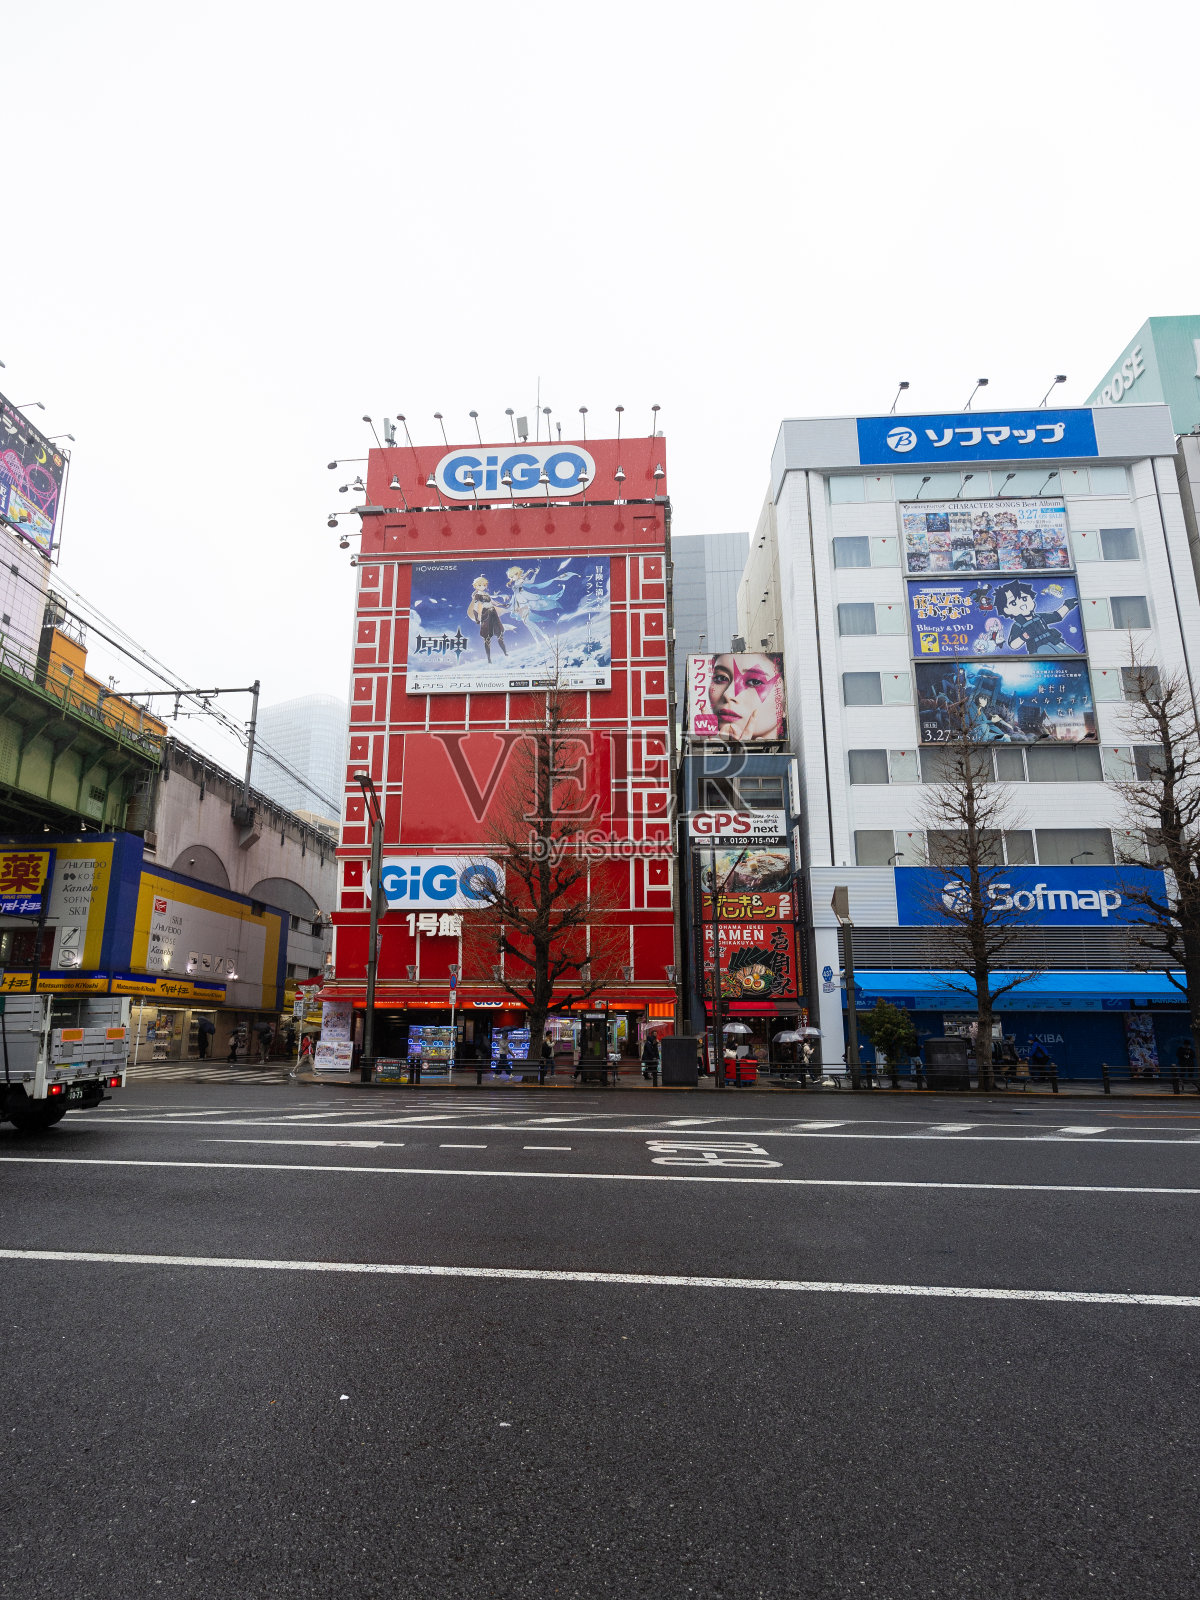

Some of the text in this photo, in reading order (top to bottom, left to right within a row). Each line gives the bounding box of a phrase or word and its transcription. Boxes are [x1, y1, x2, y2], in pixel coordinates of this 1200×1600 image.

[925, 422, 1066, 447] ソフマップ
[443, 451, 587, 493] GiGO
[949, 502, 994, 510] CHARACTER
[995, 501, 1020, 509] SONGS
[1018, 509, 1038, 520] 3.27
[916, 624, 944, 632] Blu-ray
[953, 623, 974, 632] DVD
[941, 633, 968, 645] 3.20
[694, 658, 707, 710] ワクワク
[924, 729, 951, 741] 3.27
[692, 813, 751, 834] GPS
[753, 825, 779, 833] next
[0, 854, 43, 892] 薬
[62, 884, 98, 892] Kanebo
[381, 865, 498, 900] GiGO
[988, 883, 1122, 917] Sofmap
[155, 922, 182, 936] SHISEIDO
[406, 913, 463, 937] 1号館
[705, 930, 764, 941] RAMEN
